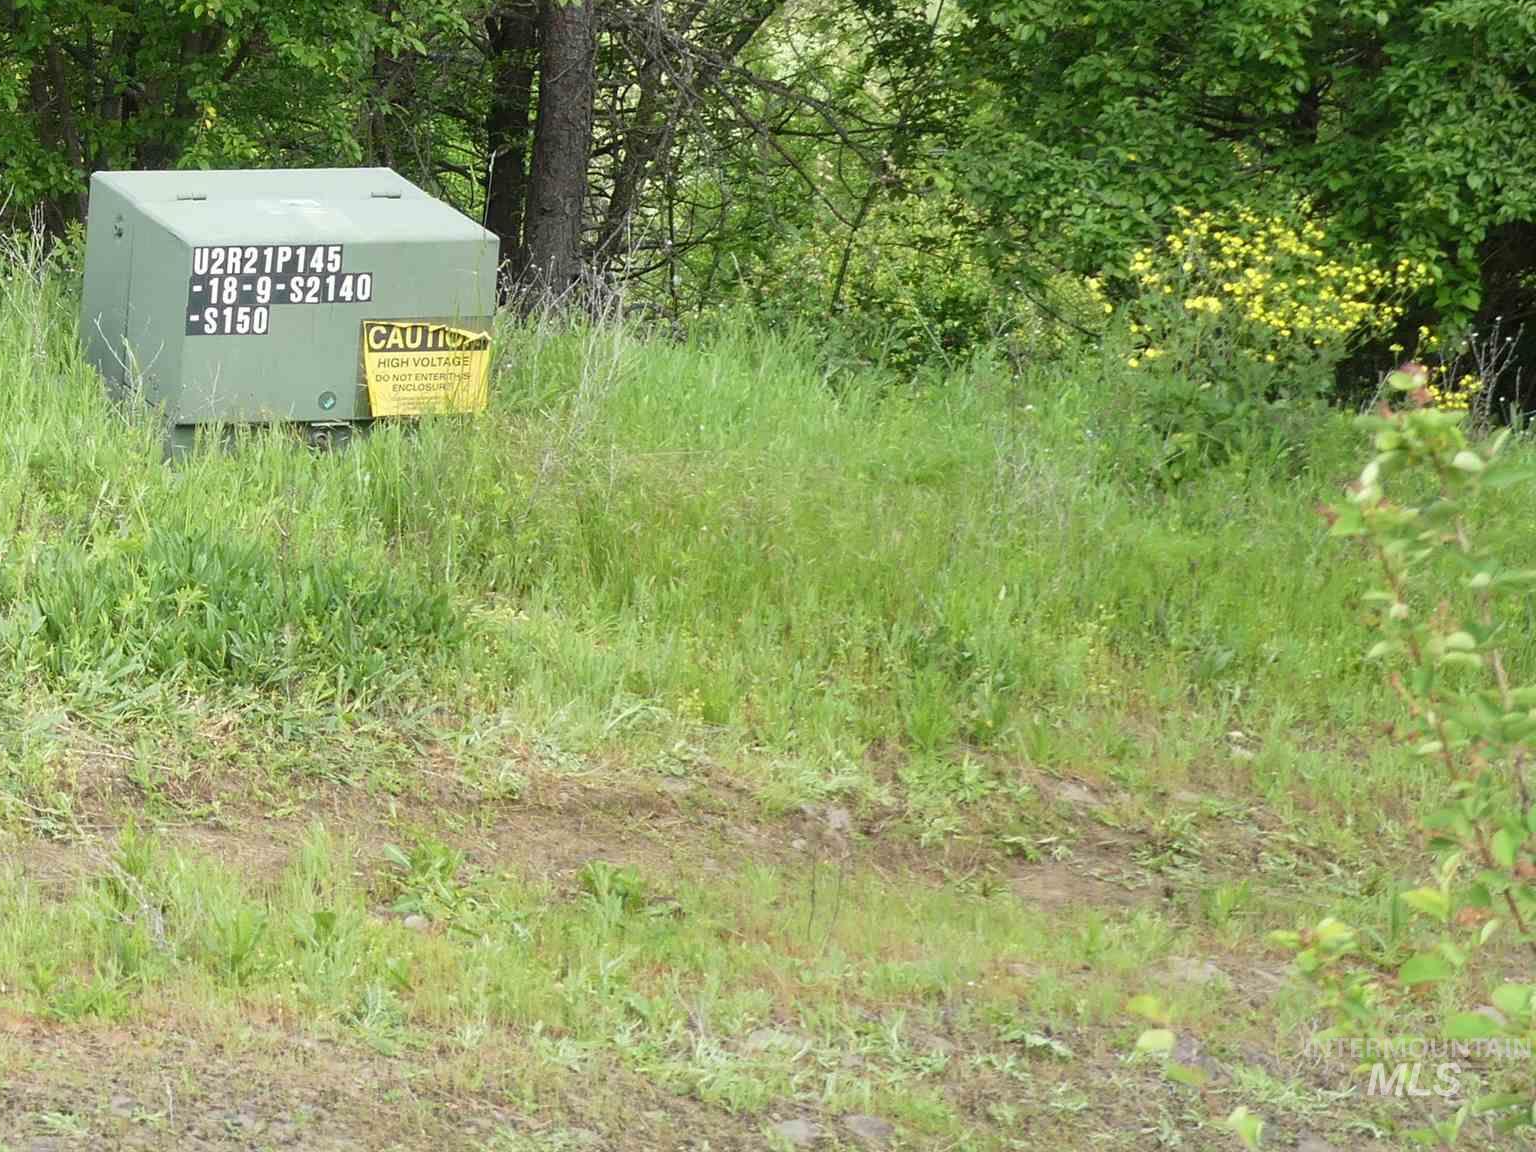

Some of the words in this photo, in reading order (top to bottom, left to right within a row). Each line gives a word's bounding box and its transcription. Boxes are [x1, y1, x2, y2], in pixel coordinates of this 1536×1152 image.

[193, 246, 341, 275] U2R21P145
[192, 274, 371, 304] -18-9-S2140
[189, 306, 268, 335] -S150
[377, 357, 409, 368] HIGH
[413, 356, 470, 368] VOLTAGE
[375, 374, 390, 382] DO
[392, 374, 412, 382] NOT
[415, 373, 447, 382] ENTER
